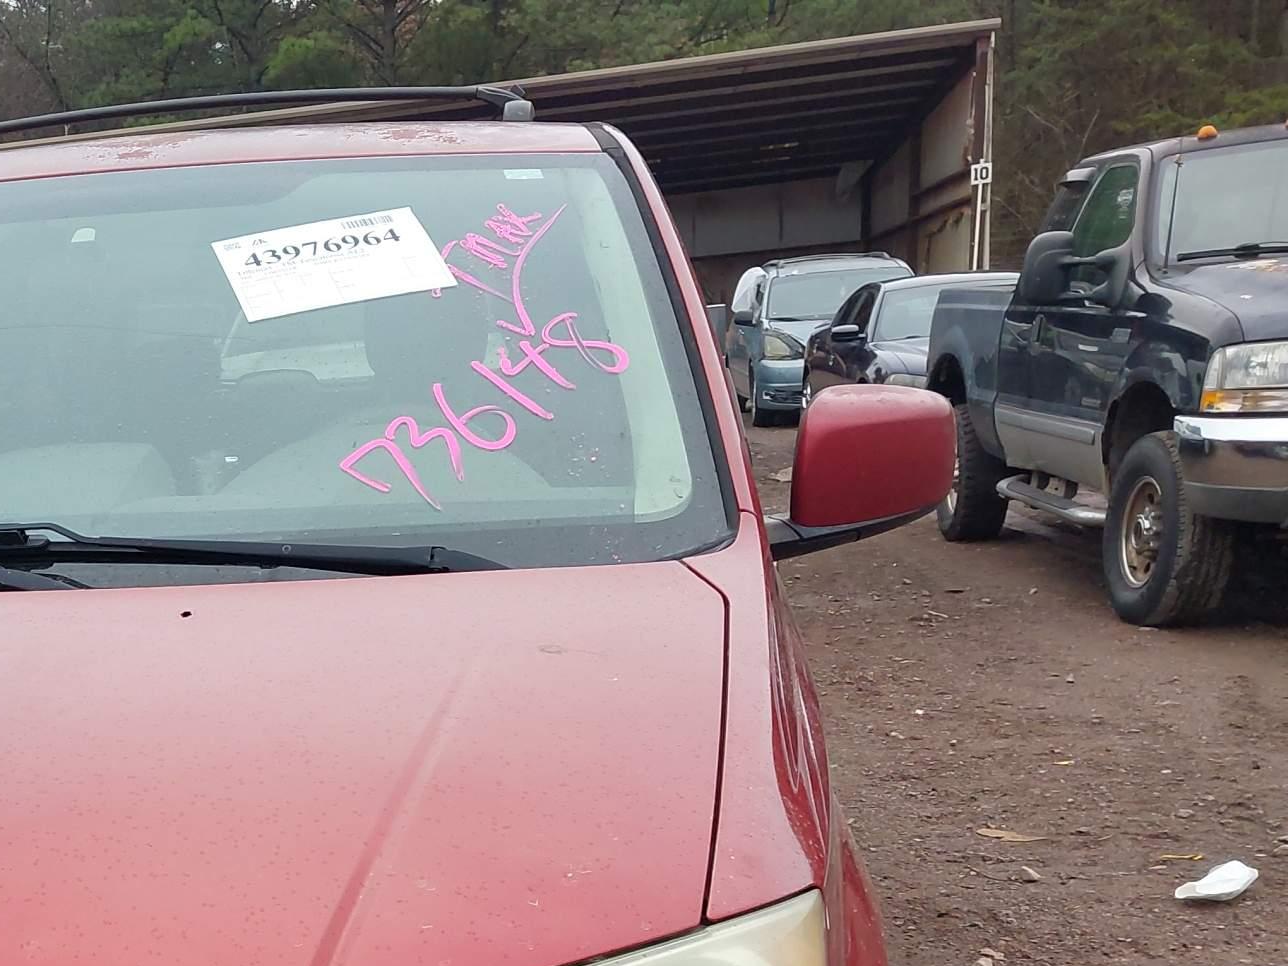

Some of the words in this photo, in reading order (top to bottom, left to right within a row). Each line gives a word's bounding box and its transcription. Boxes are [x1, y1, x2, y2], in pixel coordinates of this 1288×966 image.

[973, 166, 990, 181] 10
[244, 228, 401, 267] 43976964
[339, 311, 630, 511] 736148
